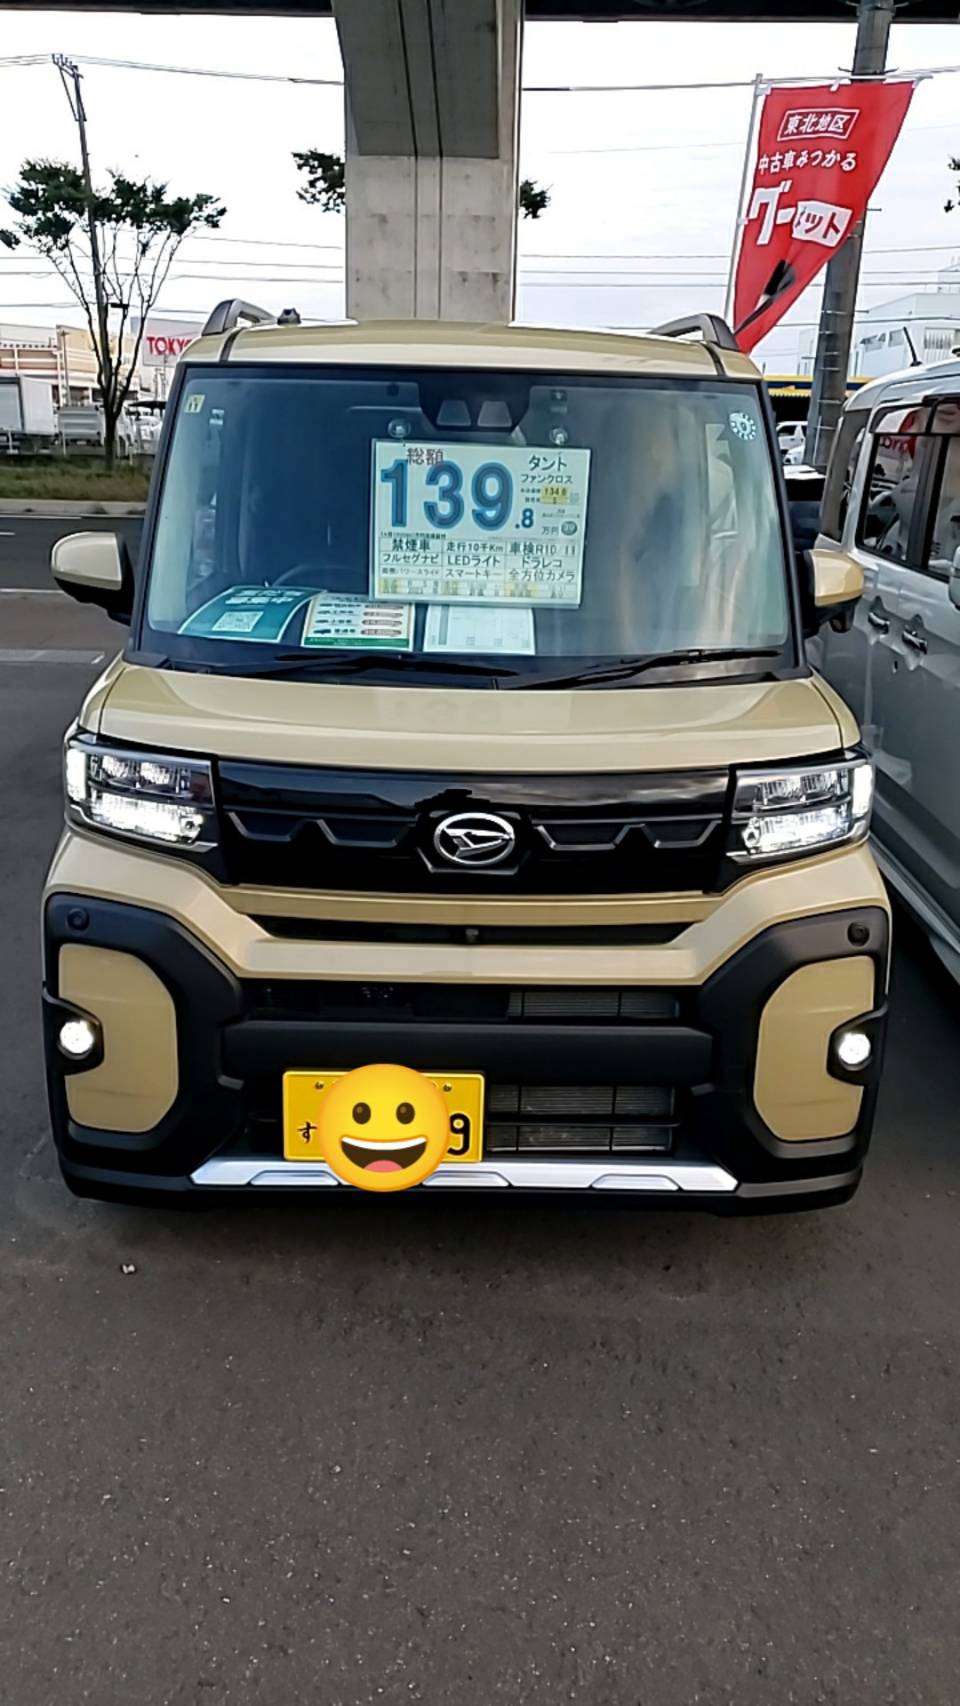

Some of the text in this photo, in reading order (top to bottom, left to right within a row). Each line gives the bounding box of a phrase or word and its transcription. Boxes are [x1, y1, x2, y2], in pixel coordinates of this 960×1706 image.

[783, 115, 851, 135] 東北地区
[758, 150, 857, 175] 中古車みつかる
[146, 336, 193, 356] TOKY
[406, 448, 444, 466] 総額
[528, 455, 568, 472] タント
[520, 473, 574, 485] ファンクロス
[382, 553, 440, 564] フルセグナビ
[447, 555, 501, 568] LEDライト
[521, 555, 563, 569] ドラレコ
[445, 568, 503, 579] スマートキー
[509, 568, 577, 582] 全方位カメラ
[297, 1121, 318, 1144] す
[448, 1112, 471, 1156] 9
